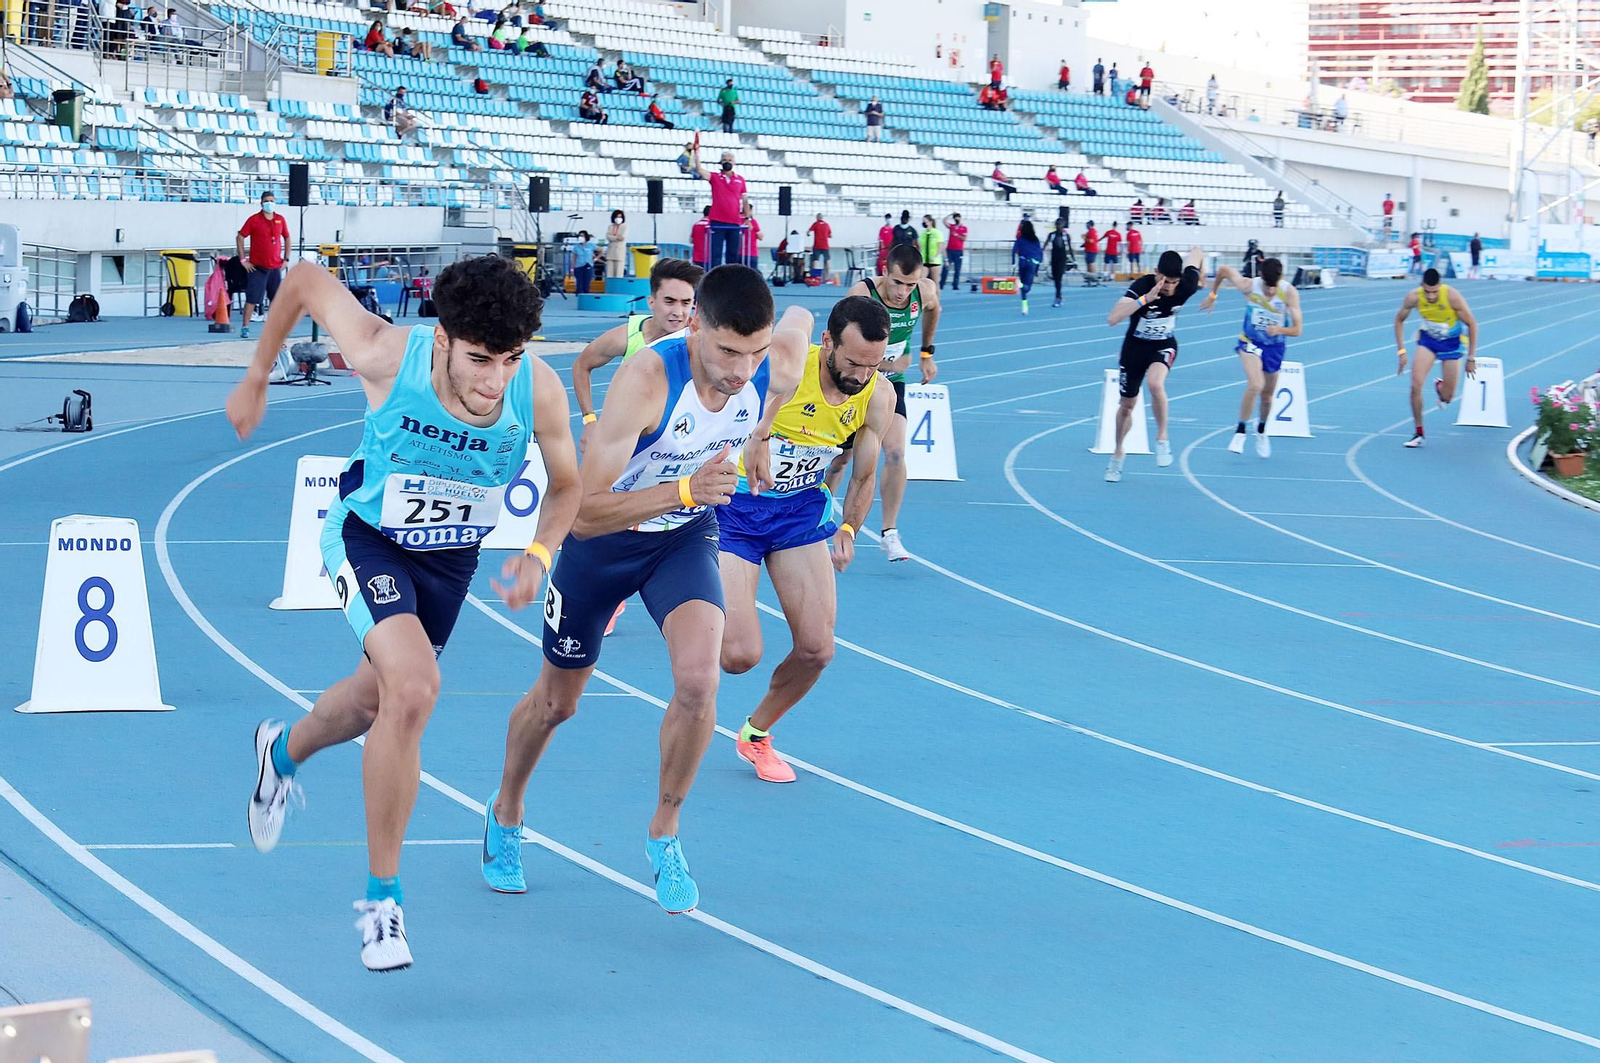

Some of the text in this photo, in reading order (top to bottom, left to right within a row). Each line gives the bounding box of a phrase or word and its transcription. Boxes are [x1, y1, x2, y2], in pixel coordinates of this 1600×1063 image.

[908, 392, 945, 400] MONDO
[1275, 387, 1293, 422] 2
[1480, 380, 1486, 412] 1
[400, 414, 490, 453] nerja
[910, 410, 935, 453] 4
[408, 439, 473, 462] ATLETISMO
[775, 457, 821, 479] 250
[304, 476, 339, 488] MON
[445, 487, 486, 500] HUELVA
[503, 459, 540, 518] 6
[404, 498, 473, 525] 251
[57, 537, 132, 551] MONDO
[74, 576, 118, 663] 8
